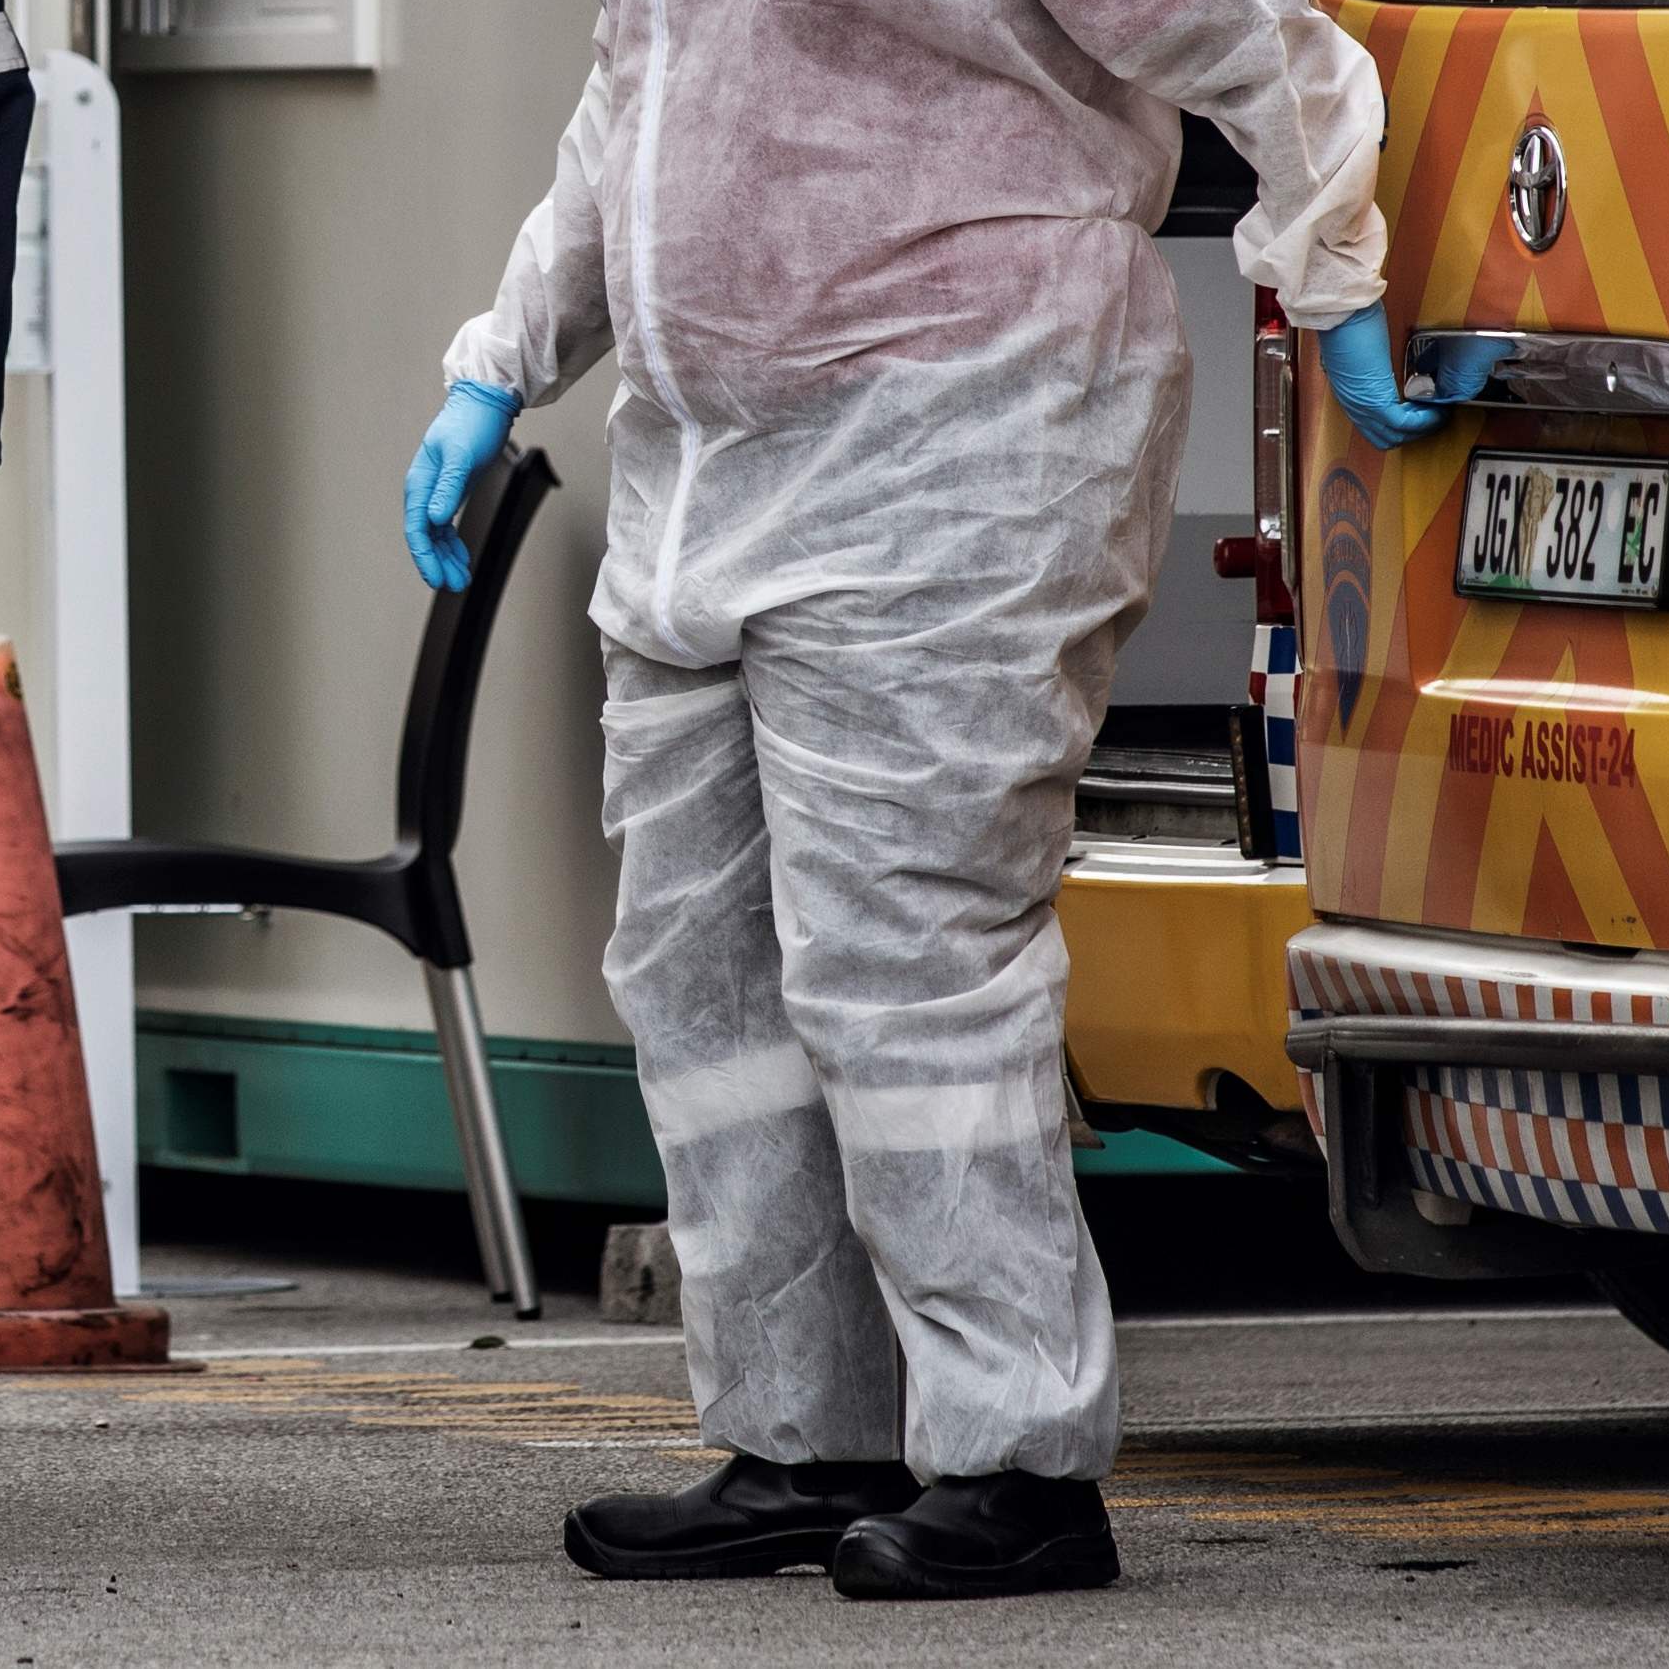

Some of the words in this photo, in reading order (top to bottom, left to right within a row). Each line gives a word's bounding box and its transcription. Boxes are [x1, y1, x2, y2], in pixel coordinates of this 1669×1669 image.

[1473, 472, 1531, 577] JGX
[1546, 477, 1605, 581] 382
[1617, 481, 1661, 585] EC
[1450, 713, 1515, 778] MEDIC
[1521, 720, 1636, 788] ASSIST-24
